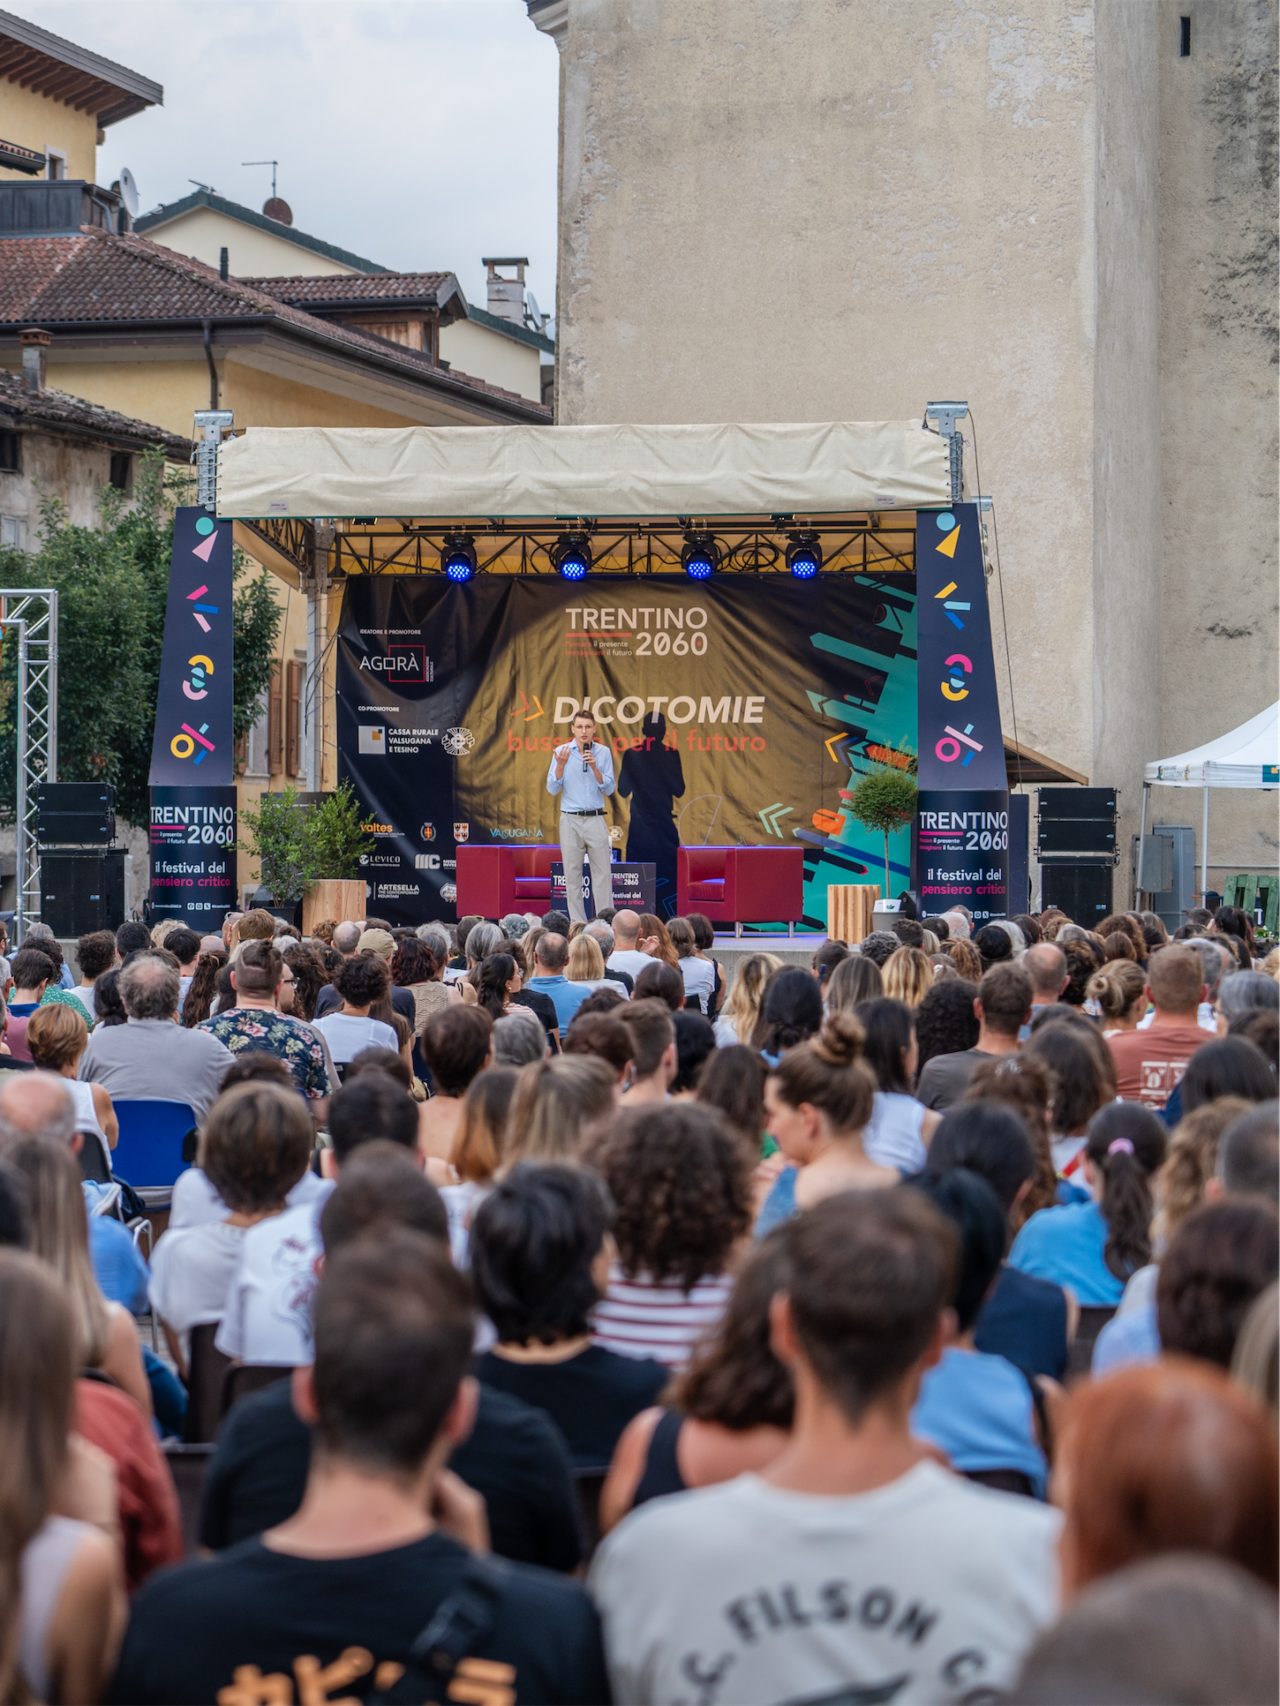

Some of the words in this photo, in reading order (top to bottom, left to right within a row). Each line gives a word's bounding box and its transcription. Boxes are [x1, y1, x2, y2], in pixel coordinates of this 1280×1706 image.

[565, 607, 708, 629] TRENTINO
[635, 631, 708, 656] 2060
[553, 695, 766, 724] DICOTOMIE
[388, 728, 411, 736] CASSA
[412, 728, 439, 736] RURALE
[507, 729, 601, 752] buss
[613, 735, 656, 756] per
[665, 730, 677, 751] il
[686, 728, 767, 753] futuro
[150, 806, 234, 824] TRENTINO
[920, 811, 1008, 830] TRENTINO
[187, 825, 234, 845] 2060
[965, 831, 1008, 851] 2060
[156, 861, 160, 873] il
[162, 861, 204, 874] festival
[208, 861, 226, 873] del
[927, 868, 934, 880] il
[936, 868, 982, 881] festival
[986, 868, 1002, 881] del
[152, 875, 194, 888] pensiero
[197, 875, 231, 887] critico
[921, 884, 973, 897] pensiero
[976, 883, 1007, 895] critico
[724, 1579, 941, 1648] FILSON
